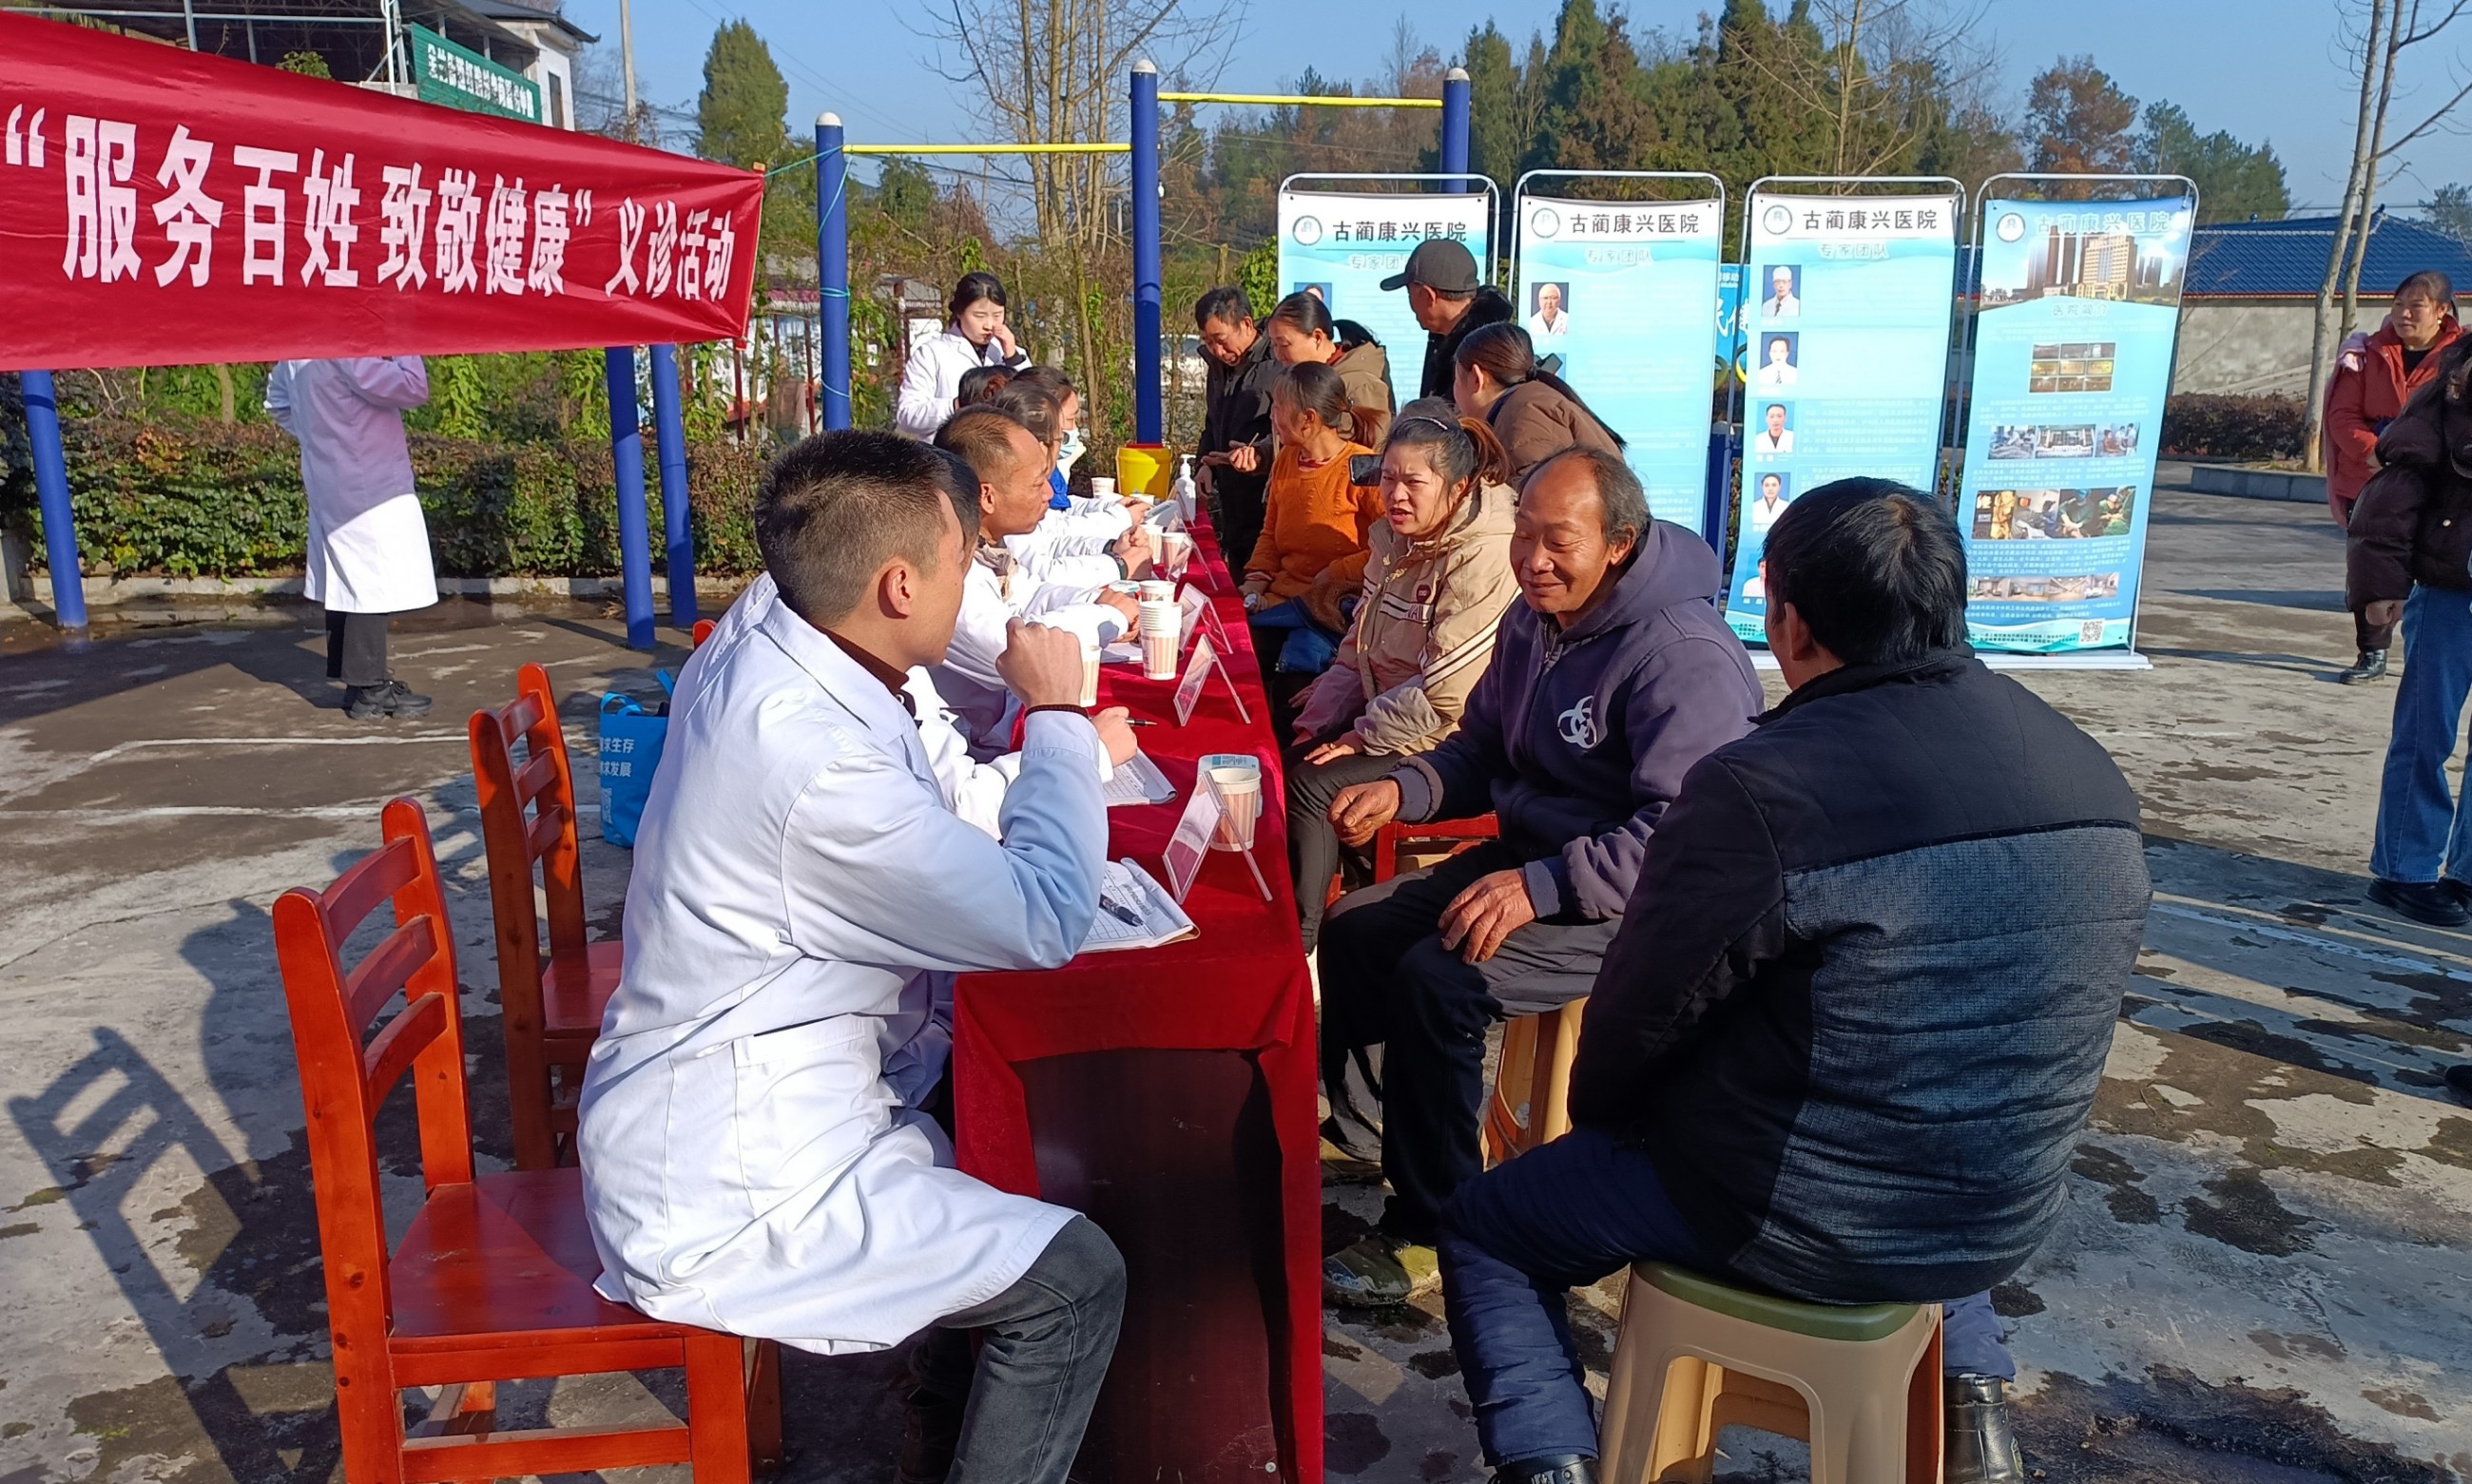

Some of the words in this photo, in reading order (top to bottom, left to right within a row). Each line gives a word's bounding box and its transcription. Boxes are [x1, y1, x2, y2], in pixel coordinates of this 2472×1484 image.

[1570, 213, 1699, 234] 古蔺康兴医院
[1803, 209, 1938, 230] 古蔺康兴医院
[2037, 211, 2172, 235] 古蔺康兴医院
[1333, 221, 1467, 242] 古蔺康兴医院
[605, 196, 736, 302] 义诊活动
[1587, 247, 1654, 265] 专家团队
[1819, 242, 1890, 260] 专家团队
[1349, 254, 1408, 270] 专家团
